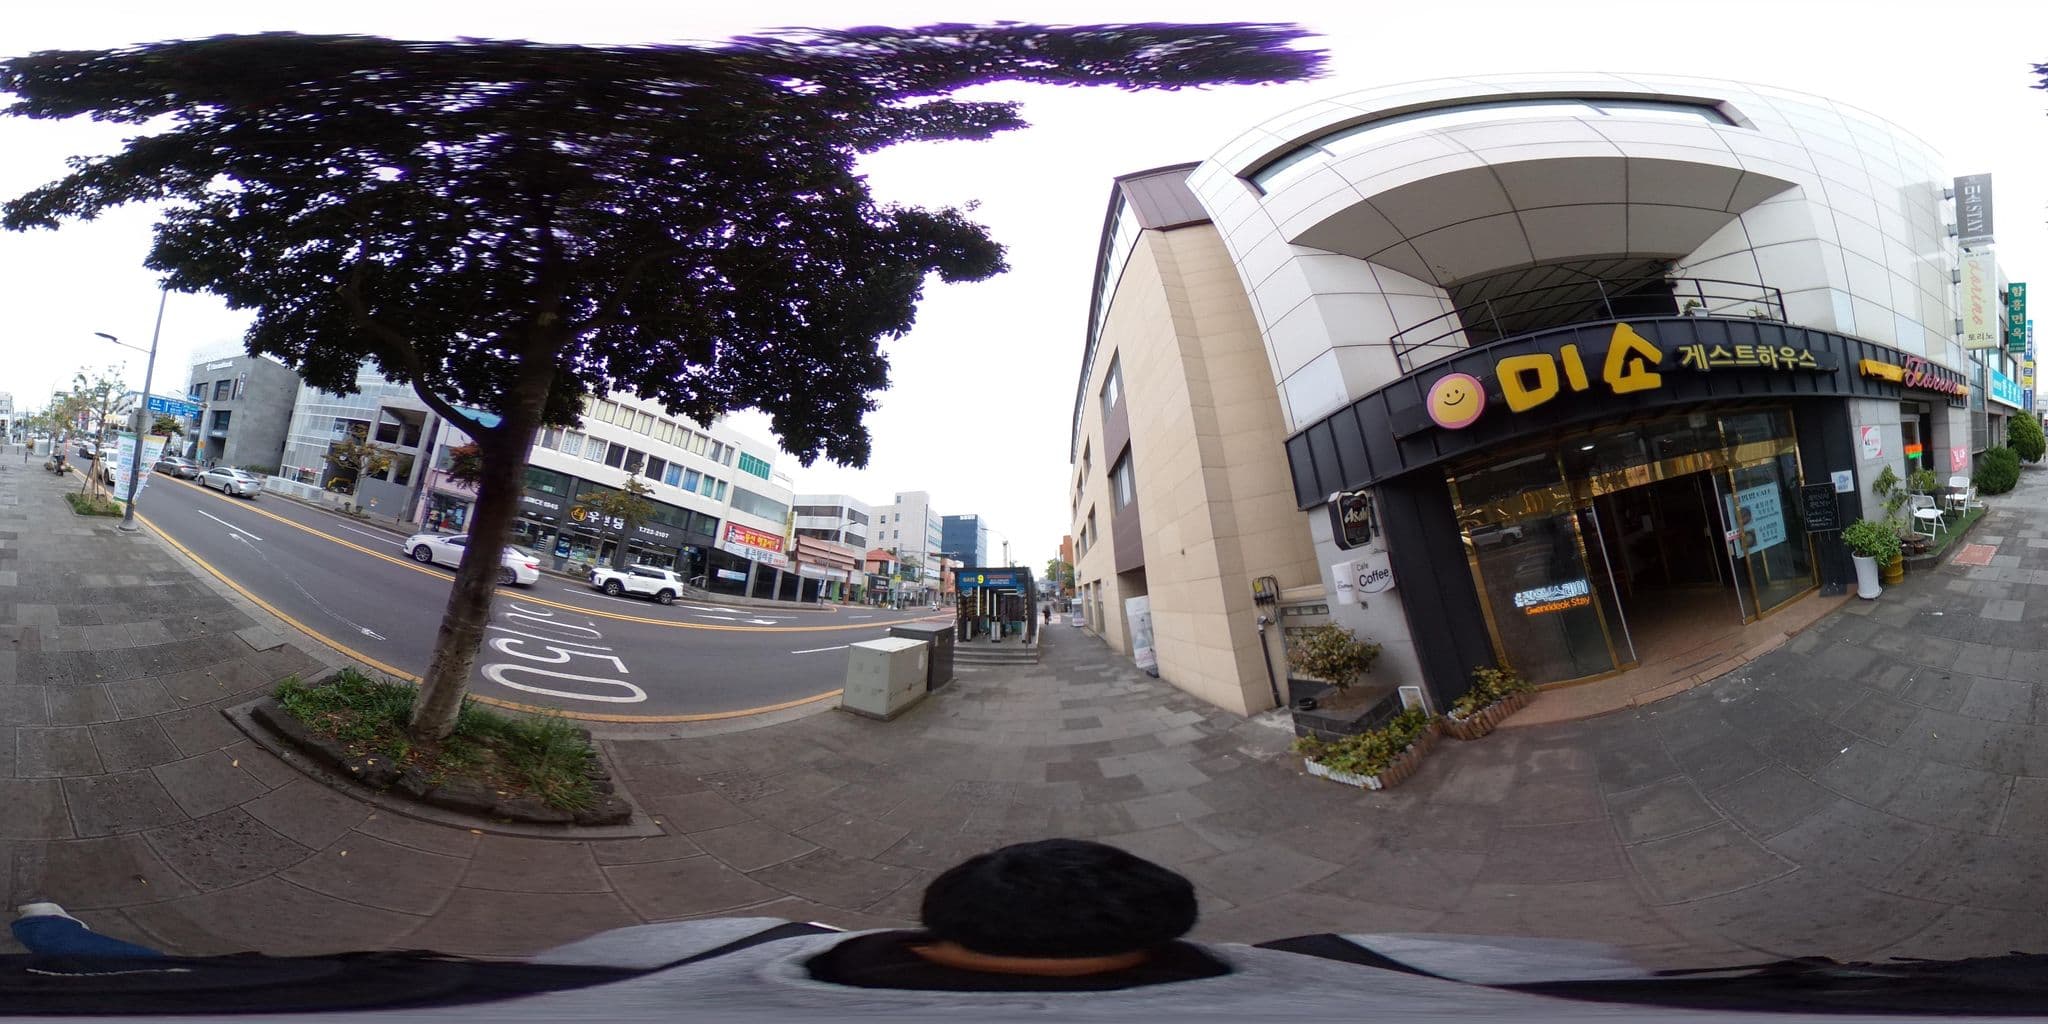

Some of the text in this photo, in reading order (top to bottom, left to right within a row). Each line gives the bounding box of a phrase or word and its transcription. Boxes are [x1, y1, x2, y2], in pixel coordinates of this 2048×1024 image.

[1967, 332, 1994, 342] 토리노
[1494, 322, 1818, 413] 미소 게스트하우스
[1356, 562, 1369, 572] Cafe
[977, 574, 985, 584] 9
[1358, 567, 1390, 588] Coffee
